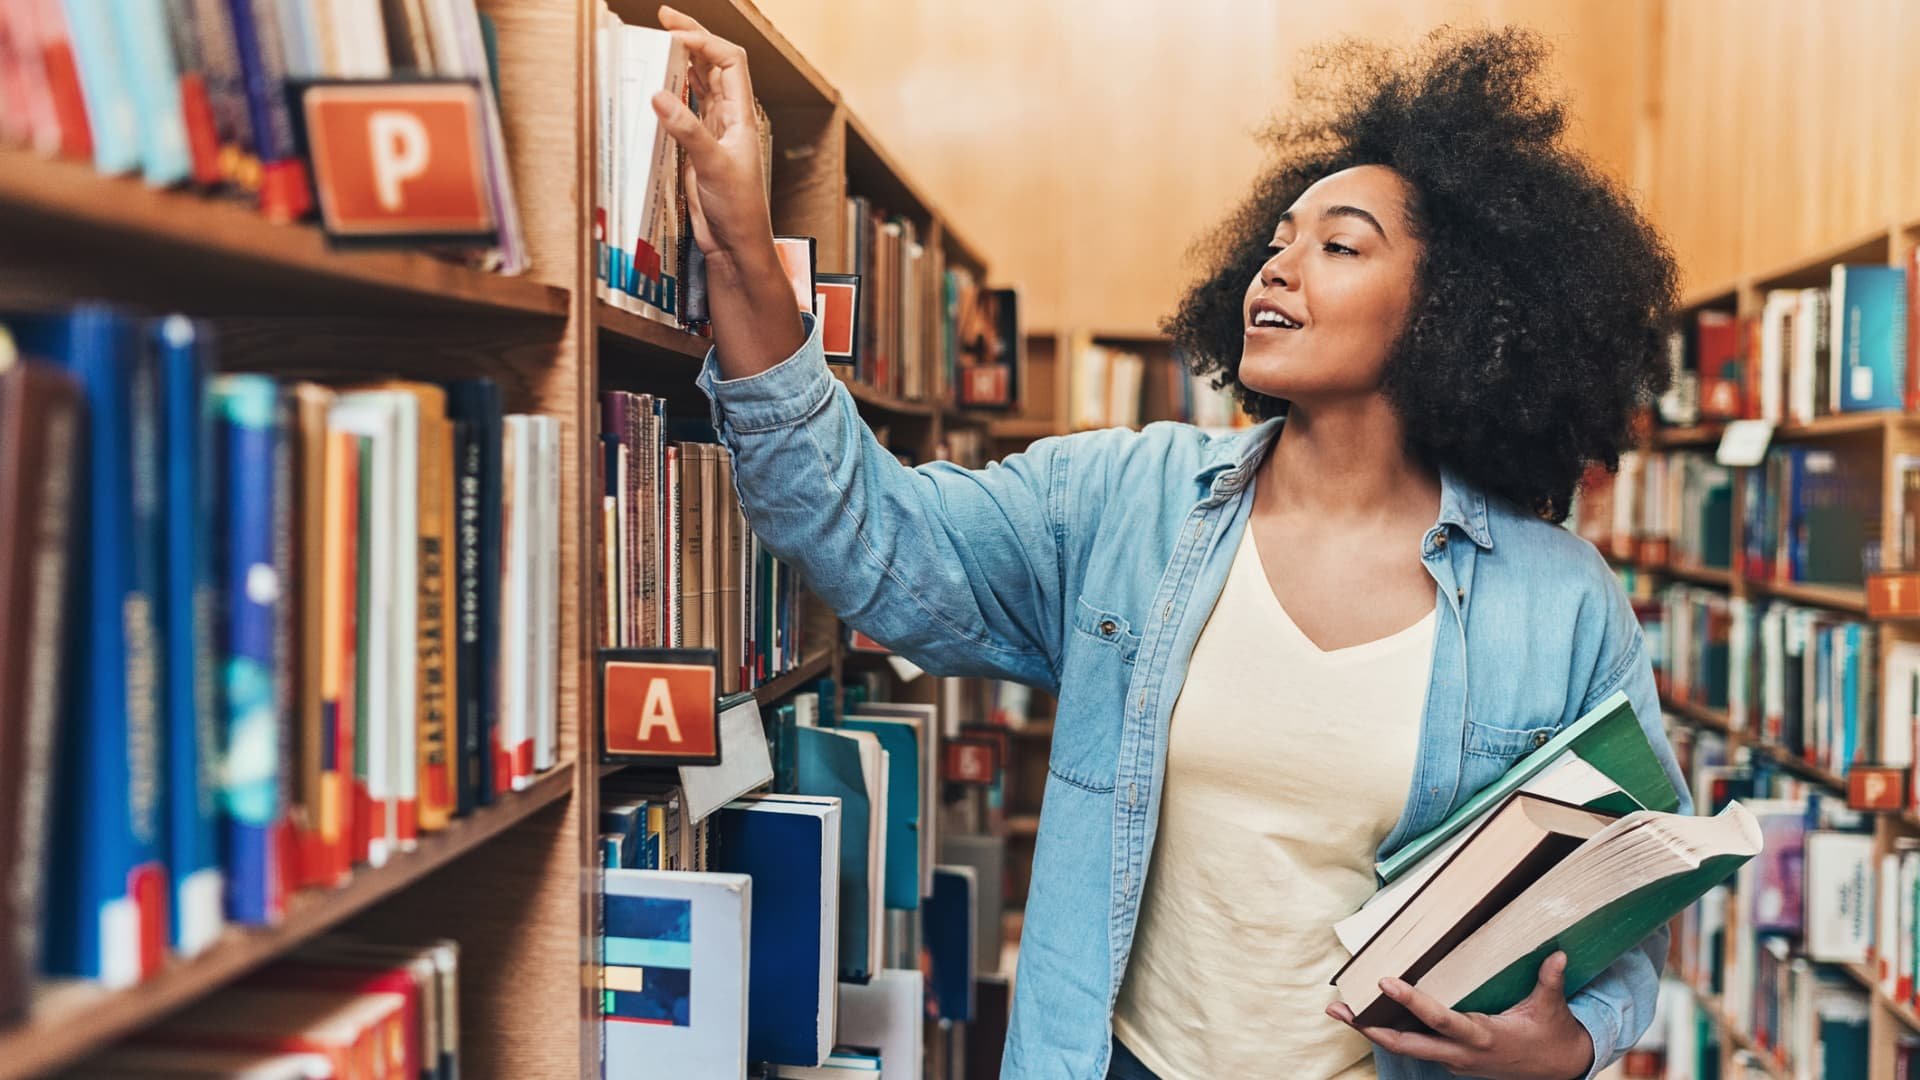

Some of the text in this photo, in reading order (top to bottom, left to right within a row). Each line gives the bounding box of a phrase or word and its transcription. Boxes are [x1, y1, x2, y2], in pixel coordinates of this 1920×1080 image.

[367, 109, 431, 212] P
[637, 677, 683, 742] A
[1864, 772, 1887, 807] P
